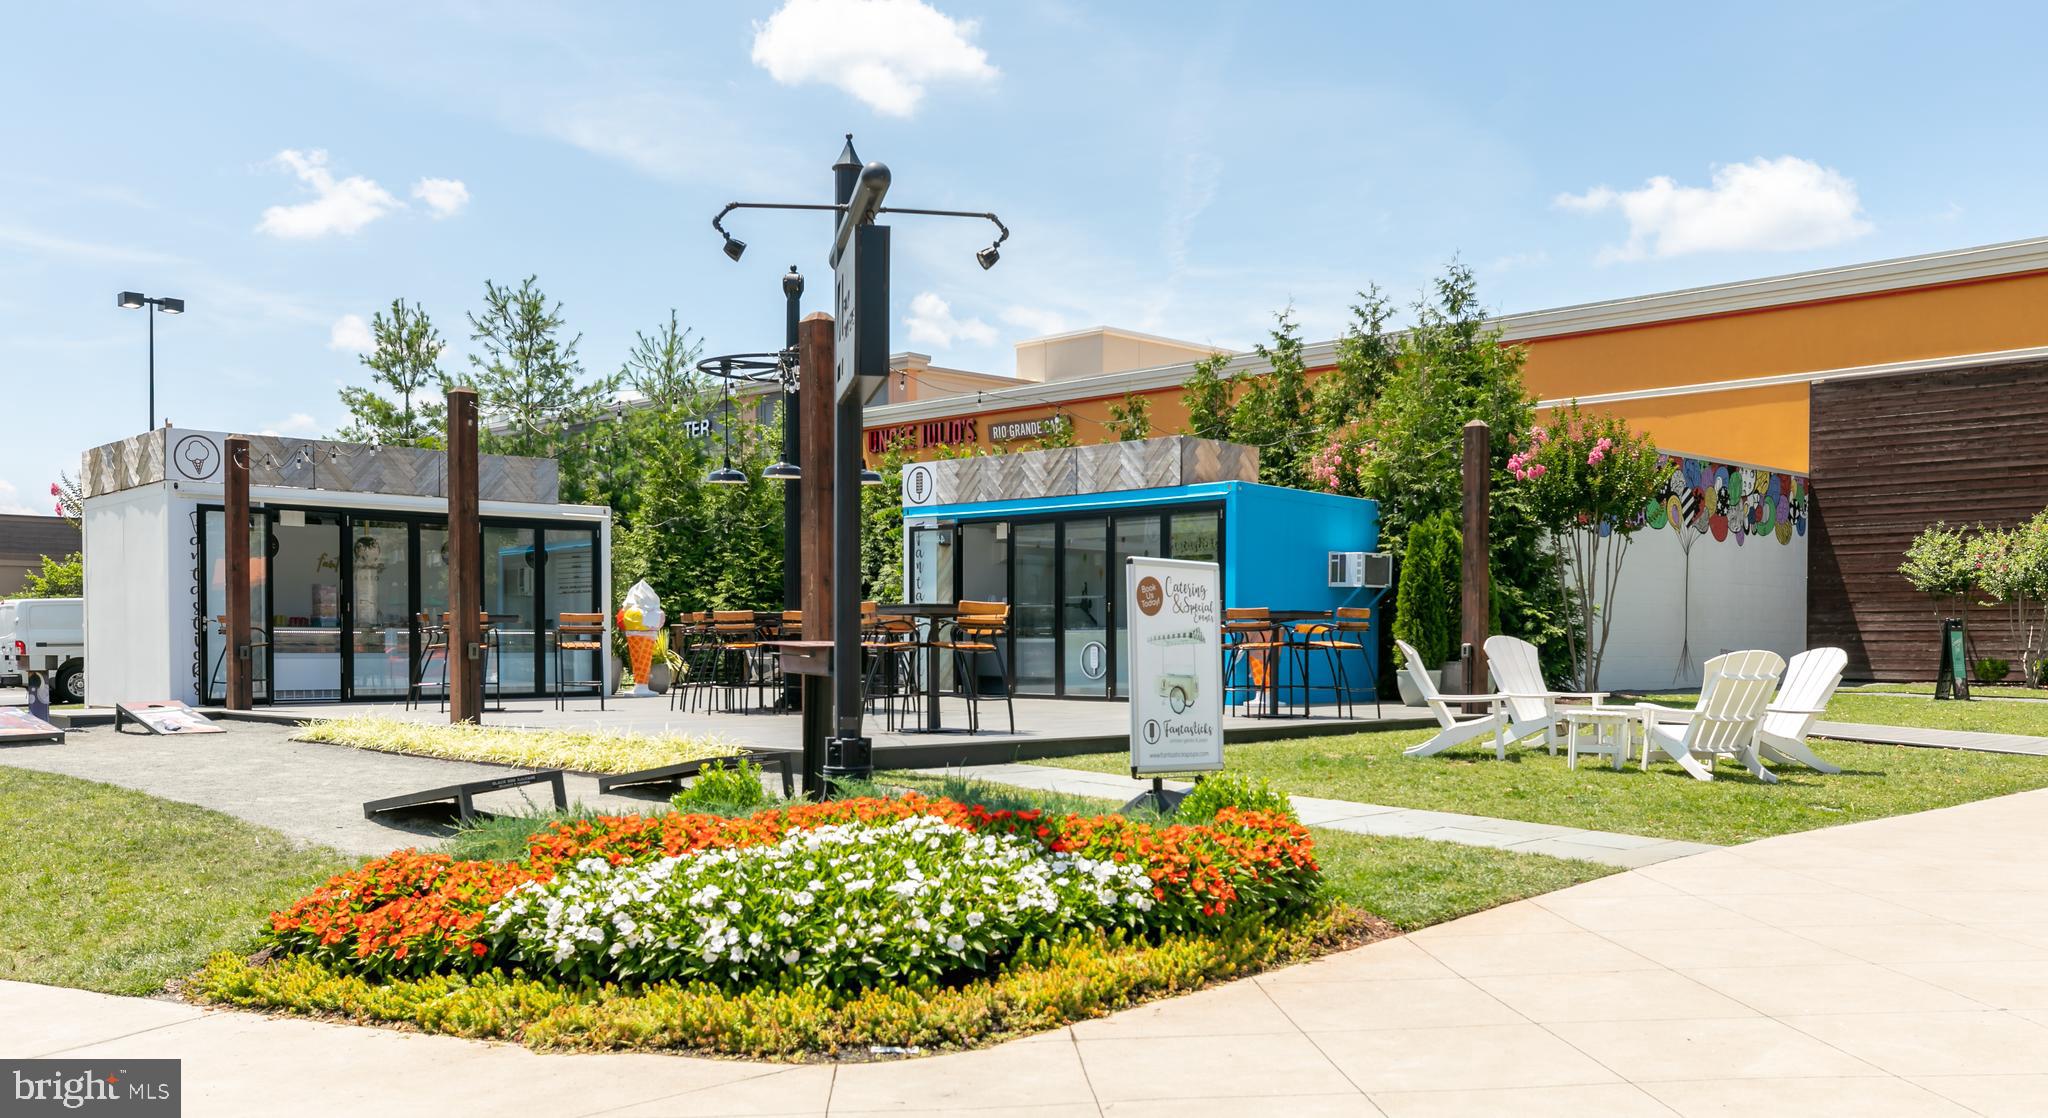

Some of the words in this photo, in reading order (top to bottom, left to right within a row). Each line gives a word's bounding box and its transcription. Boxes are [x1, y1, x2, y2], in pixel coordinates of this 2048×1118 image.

[684, 419, 710, 439] TER
[868, 424, 917, 453] UNCE
[921, 417, 977, 448] JULIO'S
[992, 425, 1007, 439] RIO
[1009, 421, 1042, 438] GRANDE
[1141, 583, 1157, 593] Book
[1165, 576, 1208, 600] Catering
[1164, 719, 1213, 737] Fantasticks
